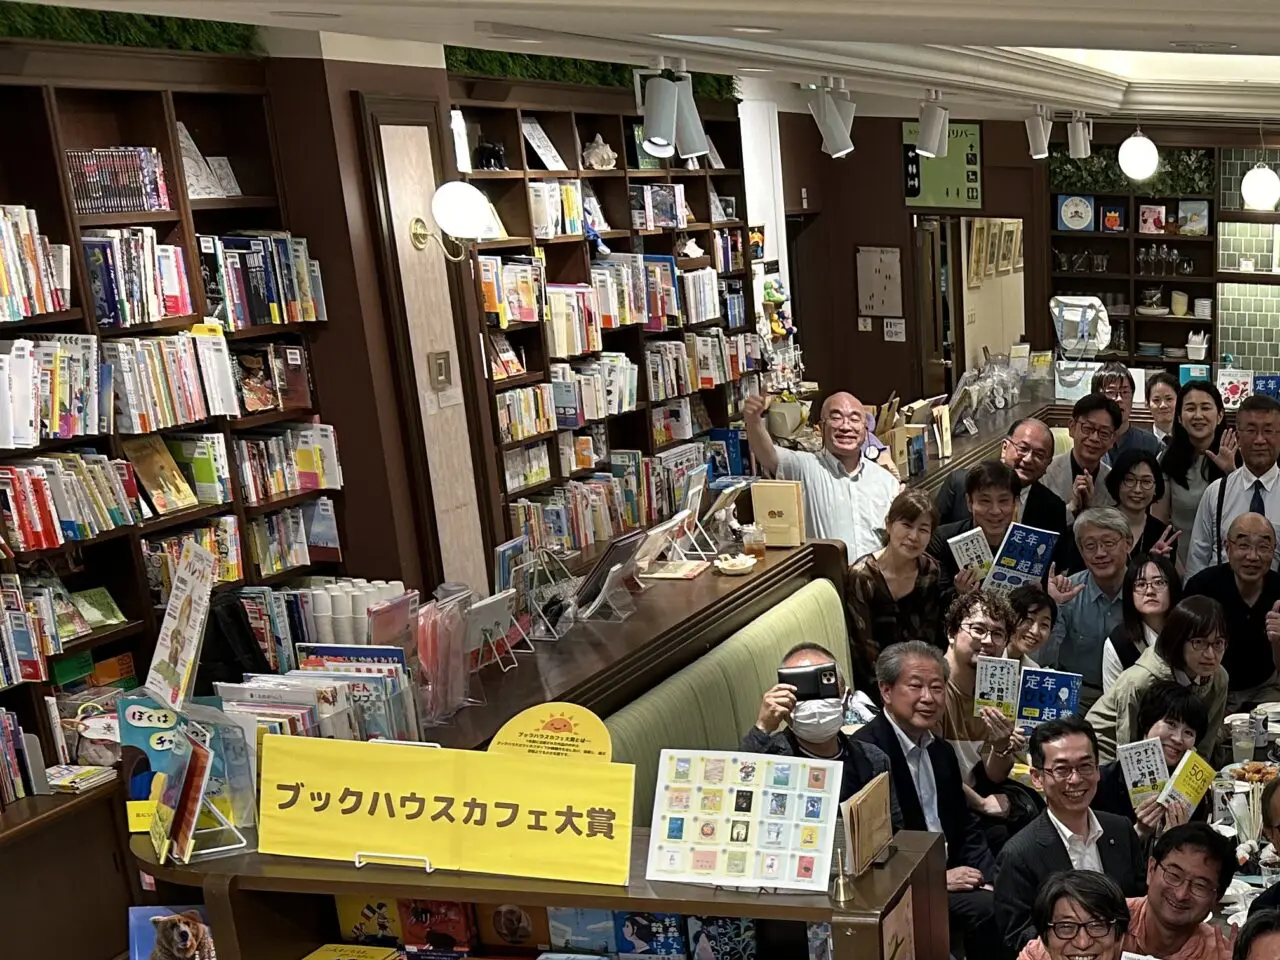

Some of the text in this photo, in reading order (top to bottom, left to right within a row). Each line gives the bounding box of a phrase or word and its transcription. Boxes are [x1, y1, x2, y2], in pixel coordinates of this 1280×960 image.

[1255, 379, 1278, 392] 定年
[1010, 530, 1039, 546] 定年
[1016, 559, 1044, 575] 起業
[1025, 674, 1056, 691] 定年
[131, 710, 169, 724] ぼくは
[275, 781, 617, 841] ブックハウスカフェ大賞
